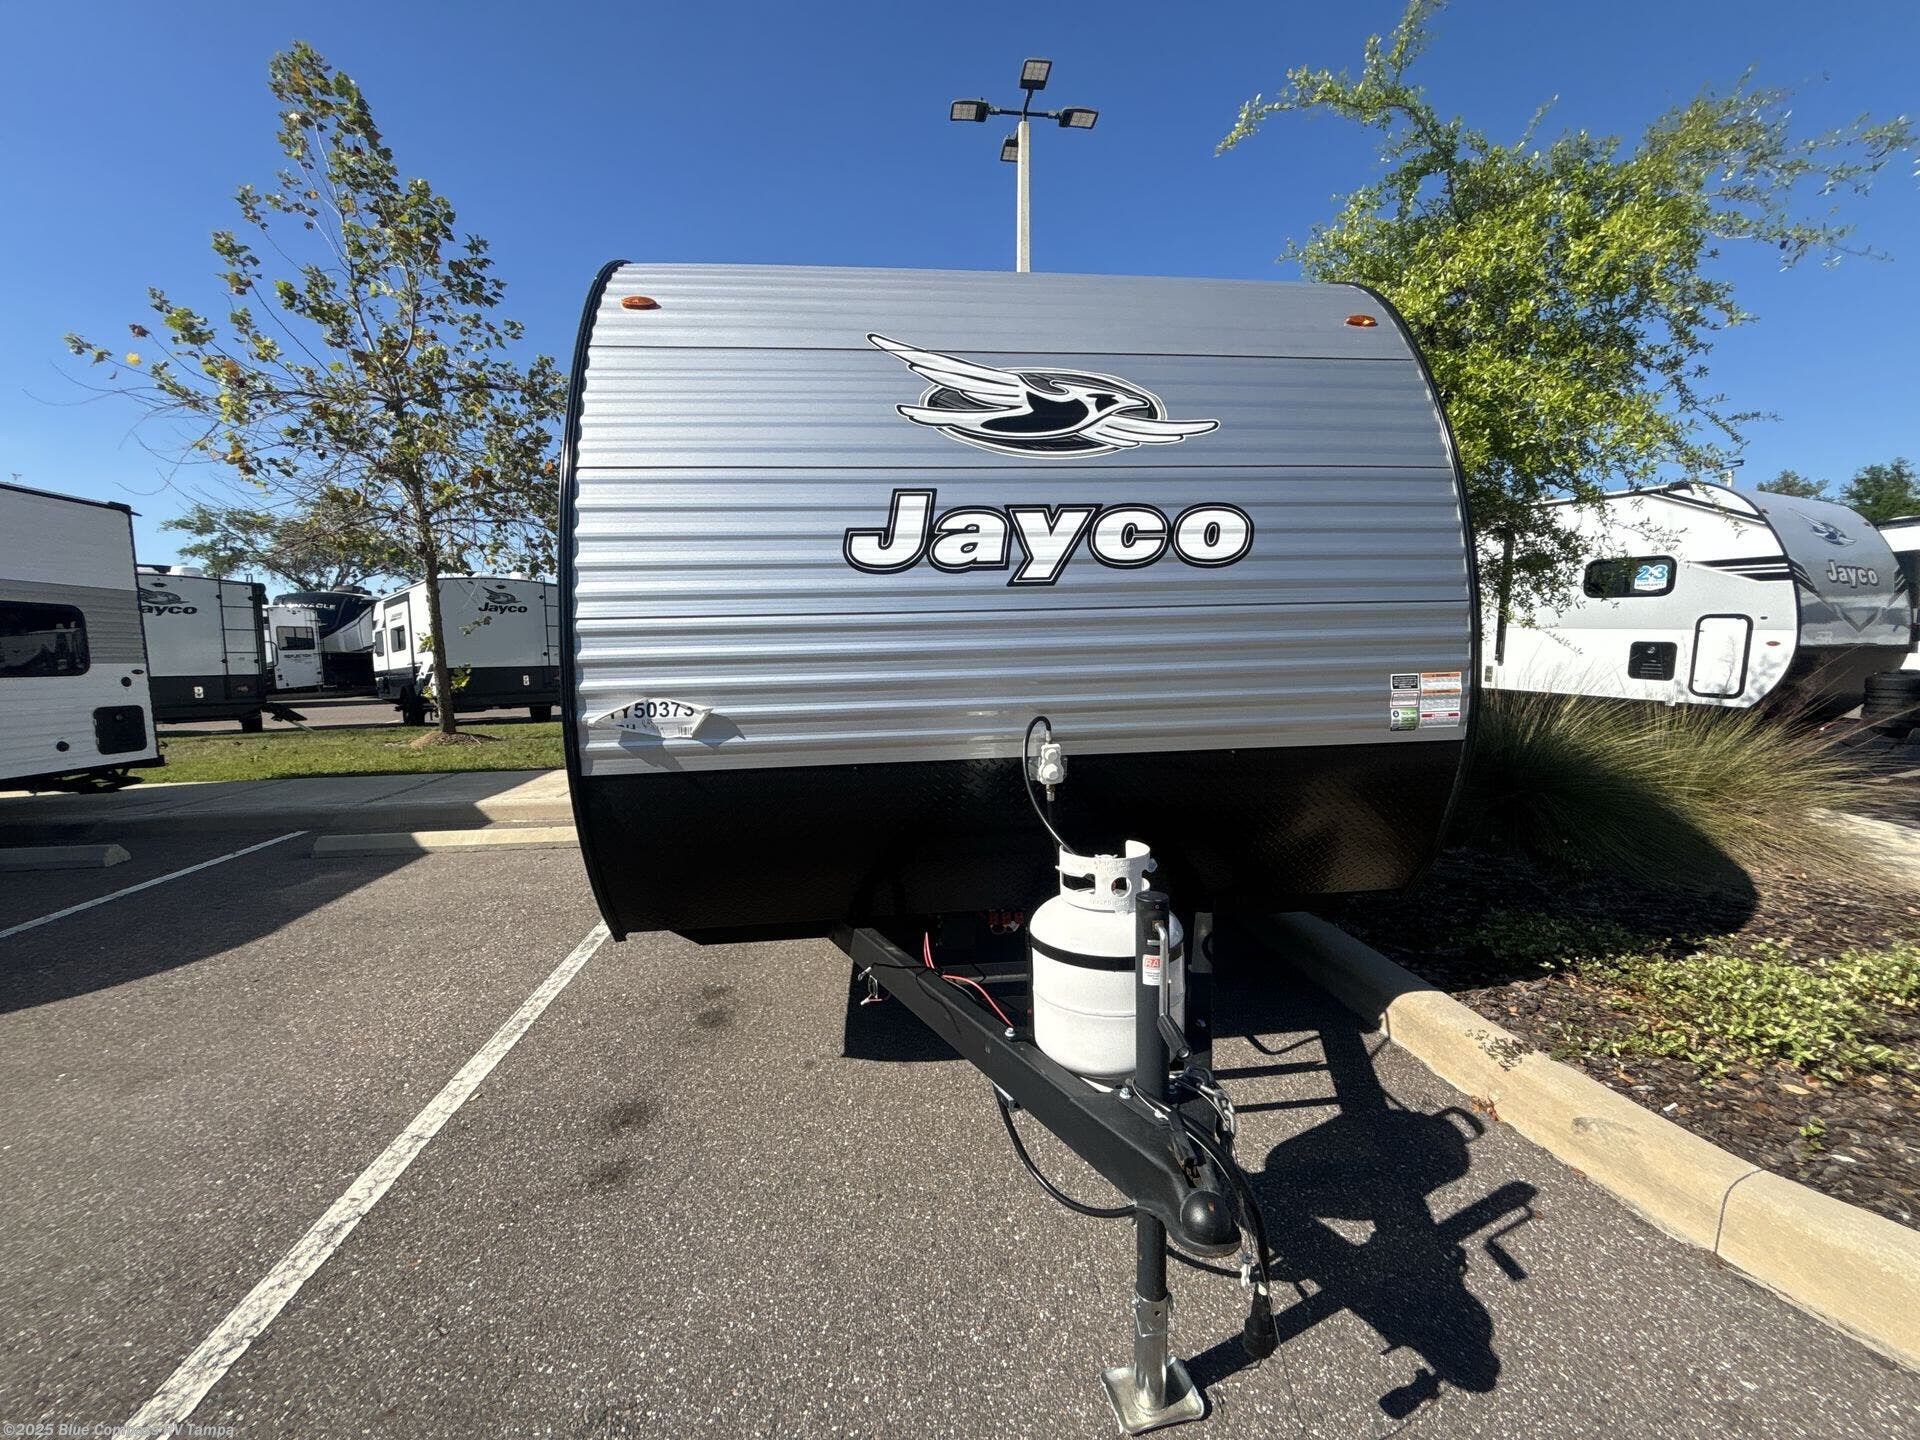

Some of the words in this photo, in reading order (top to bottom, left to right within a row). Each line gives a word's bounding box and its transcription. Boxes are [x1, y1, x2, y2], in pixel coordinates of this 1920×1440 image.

[842, 488, 1255, 587] Jayco
[1826, 559, 1879, 588] Jayco
[140, 604, 198, 616] ayco
[478, 602, 528, 614] Jayco
